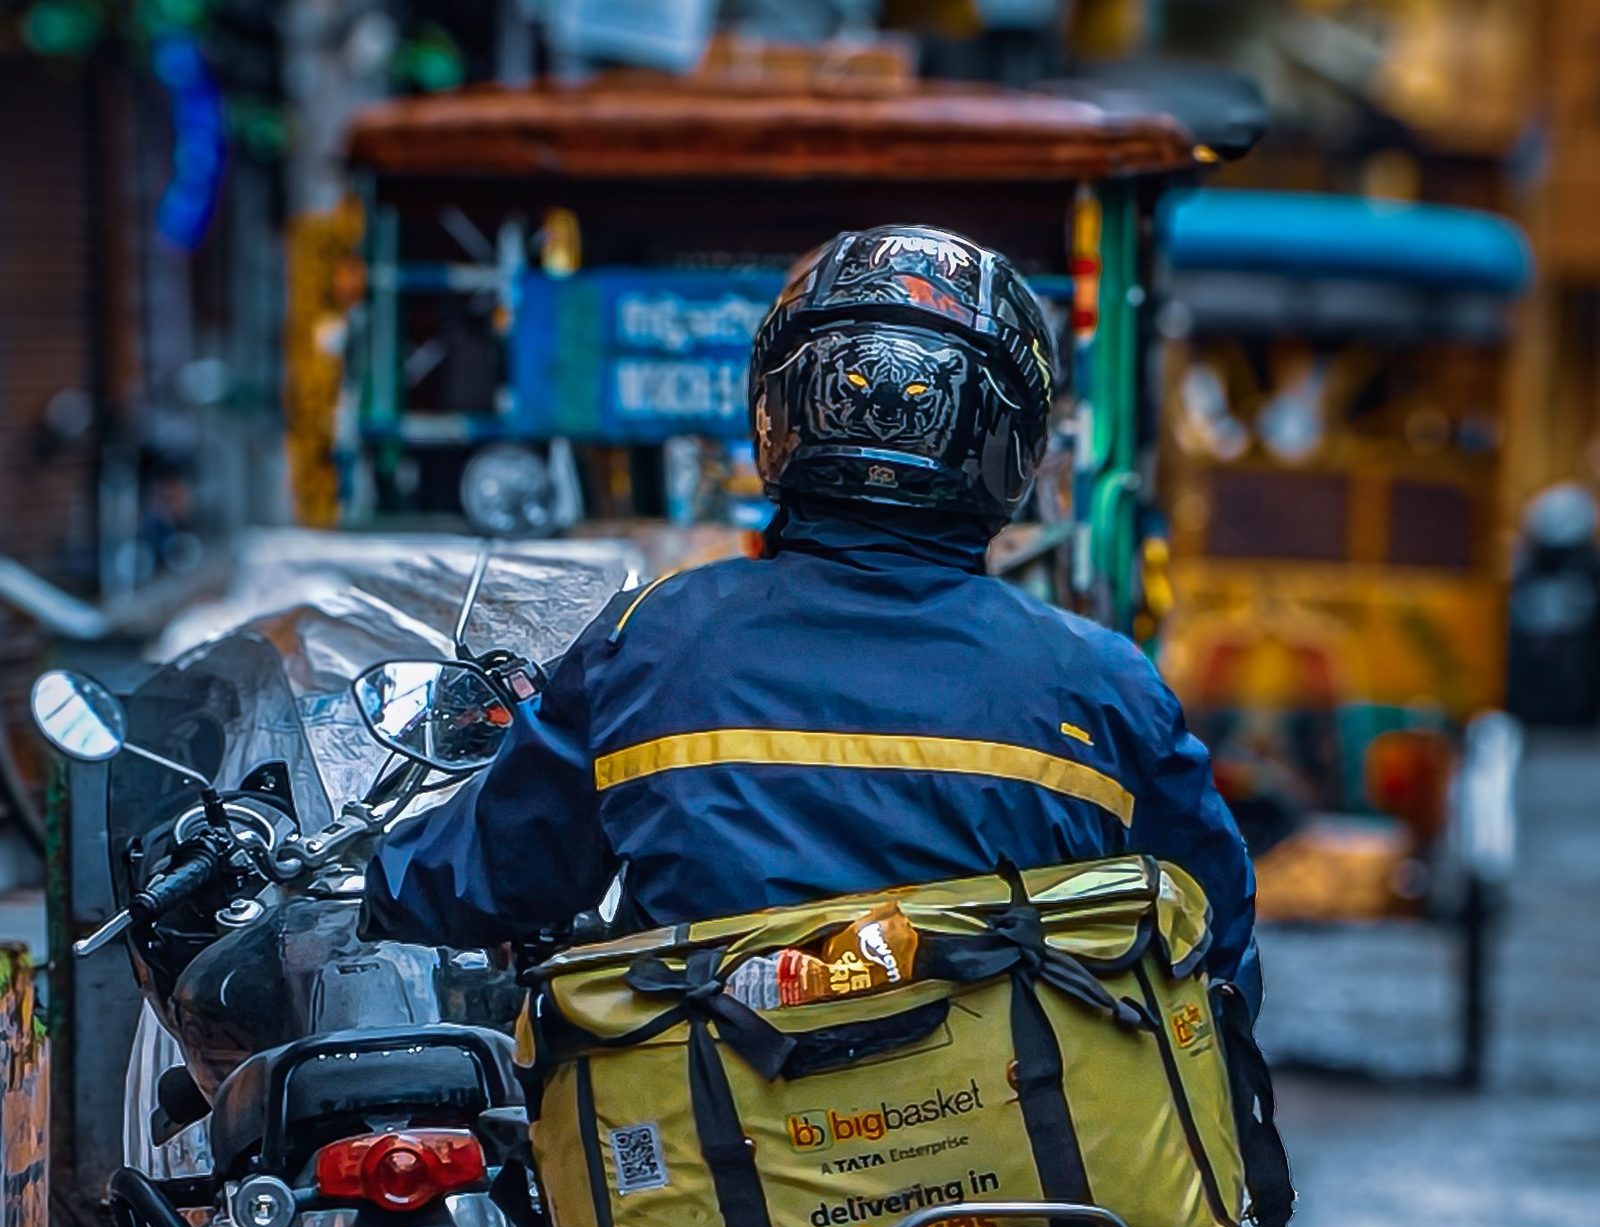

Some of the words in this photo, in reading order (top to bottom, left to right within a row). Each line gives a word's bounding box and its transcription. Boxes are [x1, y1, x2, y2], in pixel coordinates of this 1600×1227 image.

[873, 236, 970, 276] TIGERS
[831, 1078, 984, 1142] bigbasket
[834, 1153, 886, 1174] TATA
[889, 1135, 970, 1163] Enterprise
[968, 1170, 999, 1195] in
